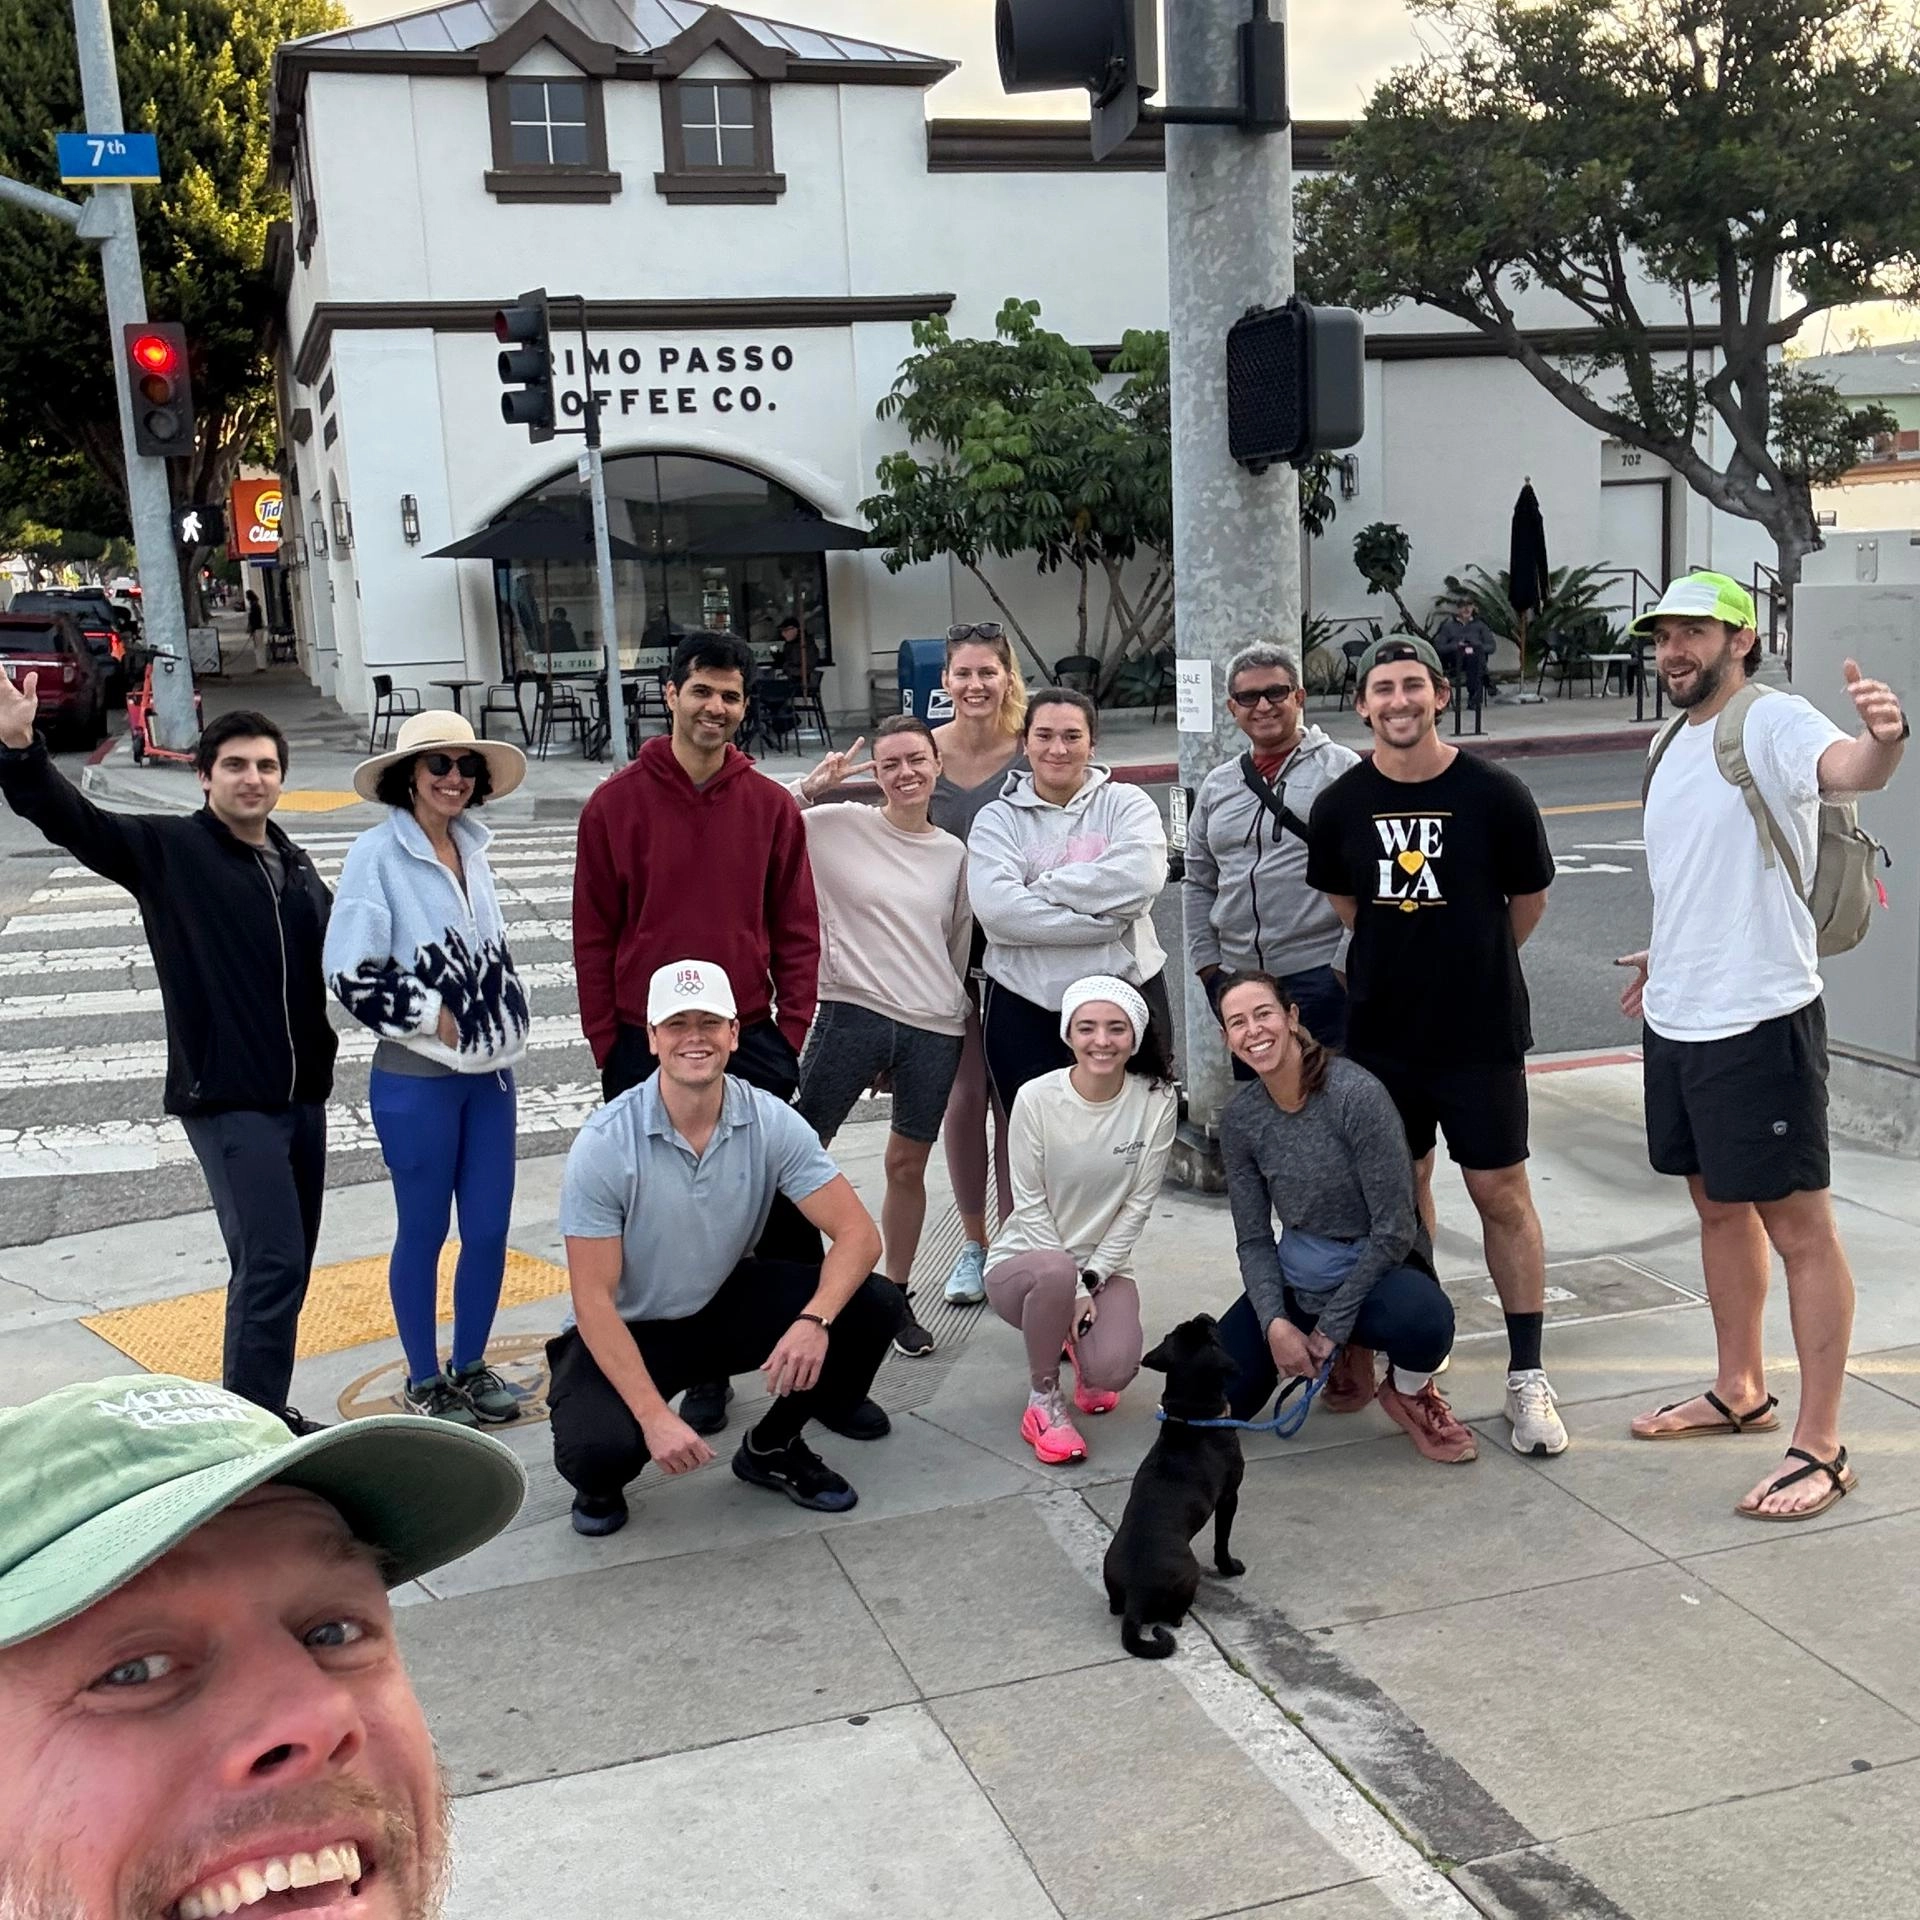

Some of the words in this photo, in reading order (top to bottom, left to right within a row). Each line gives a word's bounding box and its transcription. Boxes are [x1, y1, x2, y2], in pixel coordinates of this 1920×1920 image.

[87, 139, 126, 167] 7th
[550, 348, 641, 376] IMO
[659, 345, 793, 374] PASSO
[560, 387, 698, 416] OFFEE
[712, 386, 777, 412] CO.
[1621, 454, 1641, 466] 702
[260, 500, 285, 520] Tid
[248, 525, 279, 542] Clea
[1374, 818, 1443, 858] WE
[1377, 859, 1443, 899] LA
[676, 969, 701, 983] USA
[126, 1405, 253, 1430] Person
